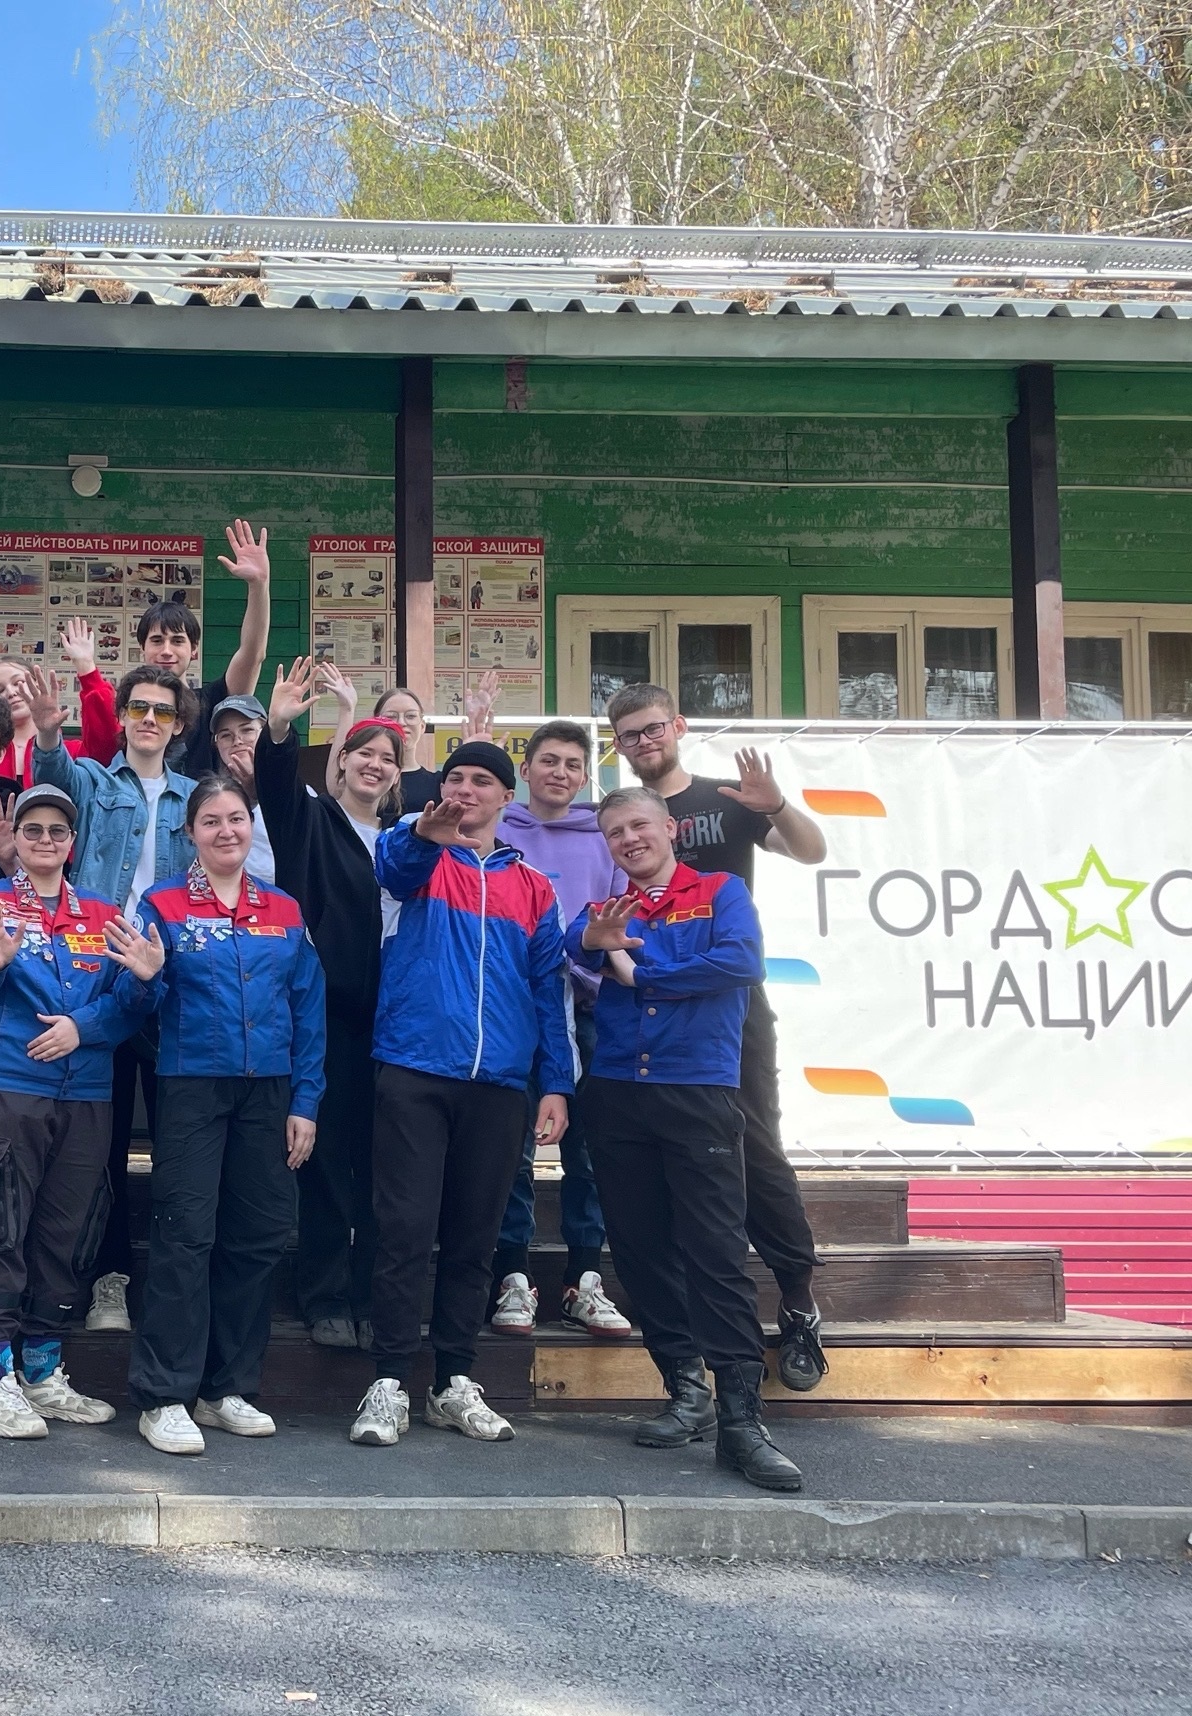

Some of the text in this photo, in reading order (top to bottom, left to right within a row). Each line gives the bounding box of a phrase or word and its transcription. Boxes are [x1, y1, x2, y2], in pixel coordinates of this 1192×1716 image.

[14, 535, 109, 550] ДЕЙСТВОВАТЬ
[113, 538, 139, 551] ПРИ
[142, 540, 198, 552] ПОЖАРЕ
[314, 540, 540, 555] УГОЛОК ГРАСКОЙ ЗАЩИТЫ
[924, 960, 1192, 1041] НАЦИИ
